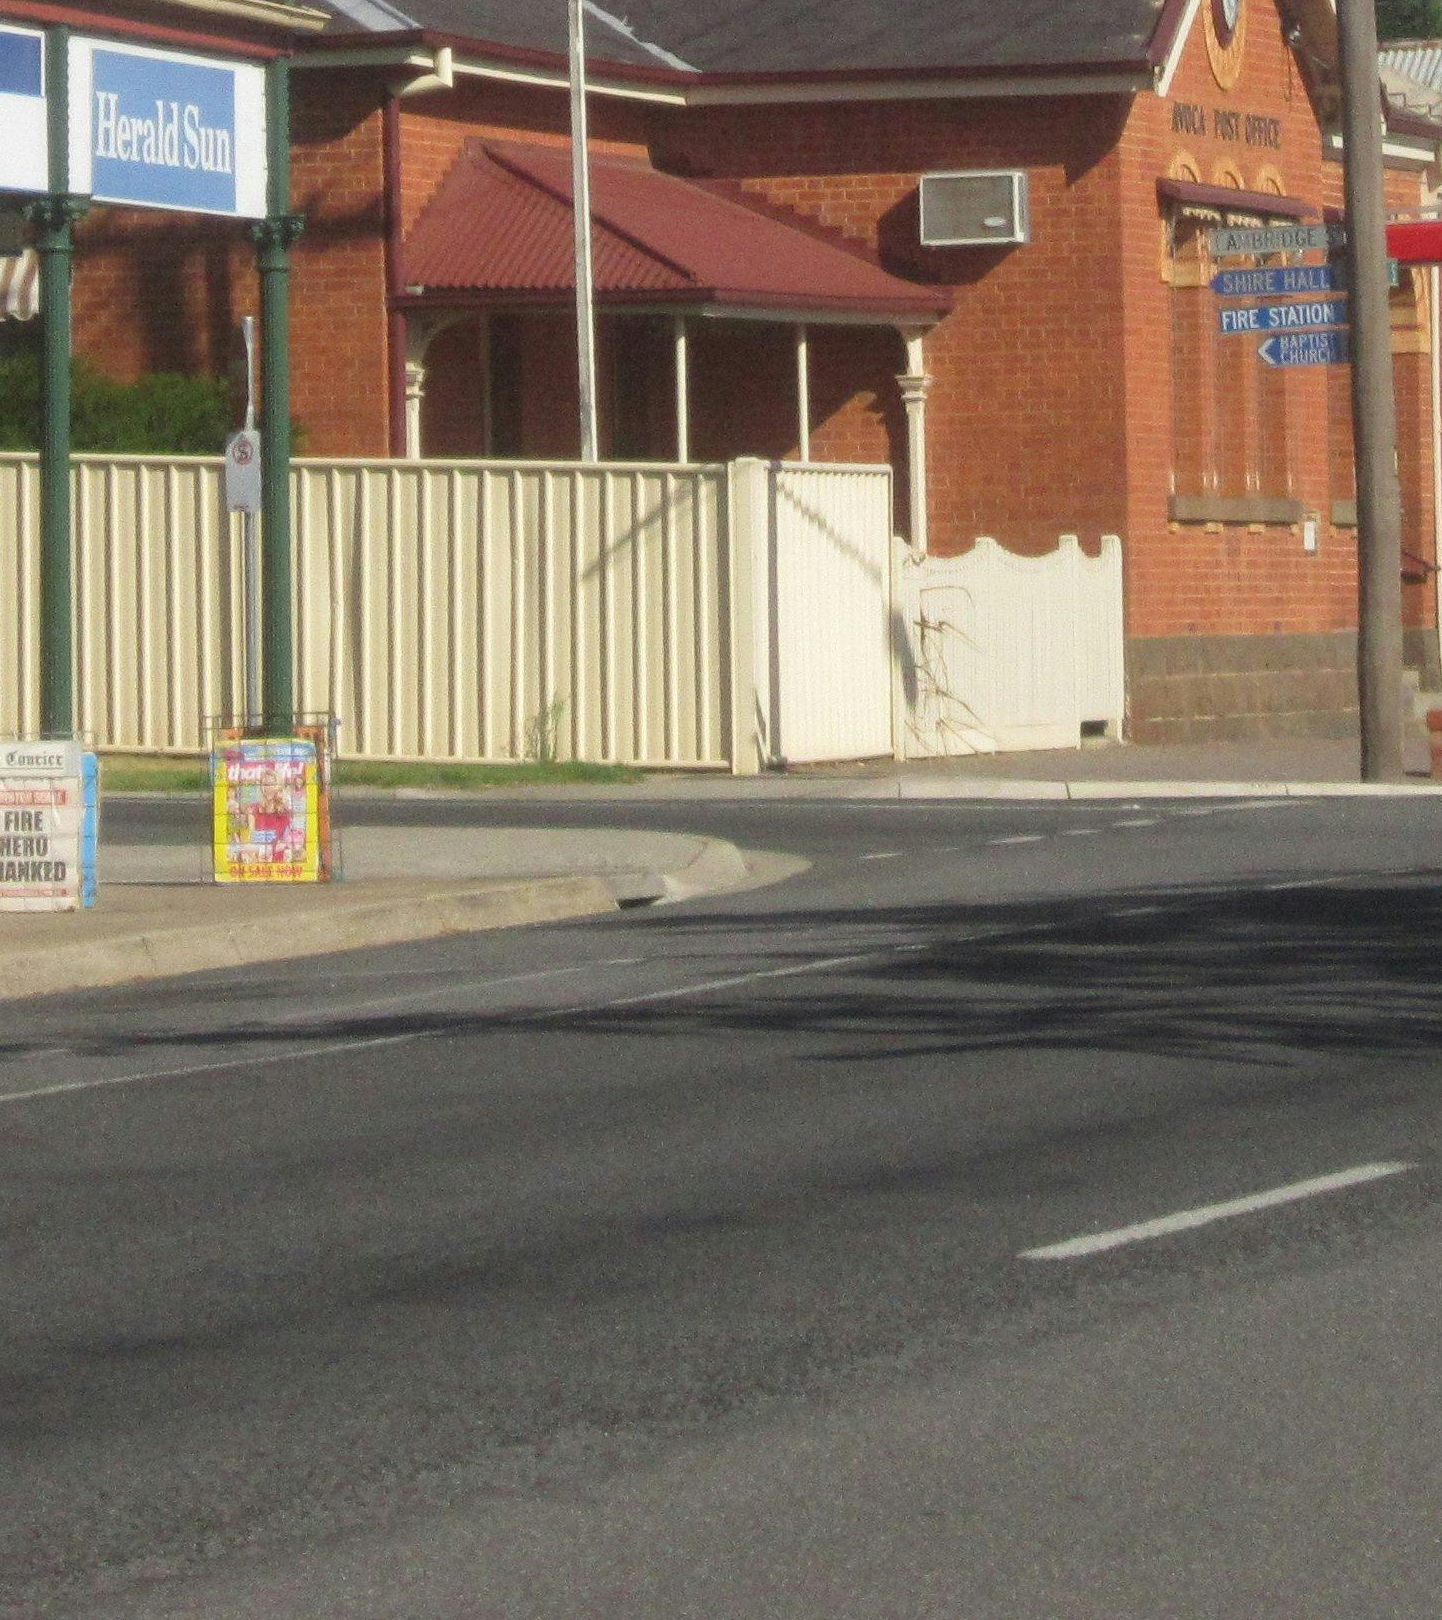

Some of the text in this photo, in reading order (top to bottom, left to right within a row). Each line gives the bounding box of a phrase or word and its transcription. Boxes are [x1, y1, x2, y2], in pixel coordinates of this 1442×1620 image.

[95, 89, 232, 176] Herald Sun
[1215, 231, 1318, 250] CAMBRIDGE
[1222, 268, 1330, 293] SHIRE HALL
[1221, 304, 1335, 330] FIRE STATION
[7, 752, 63, 767] Courier
[4, 811, 43, 830] FIRE
[0, 836, 48, 857] HERO
